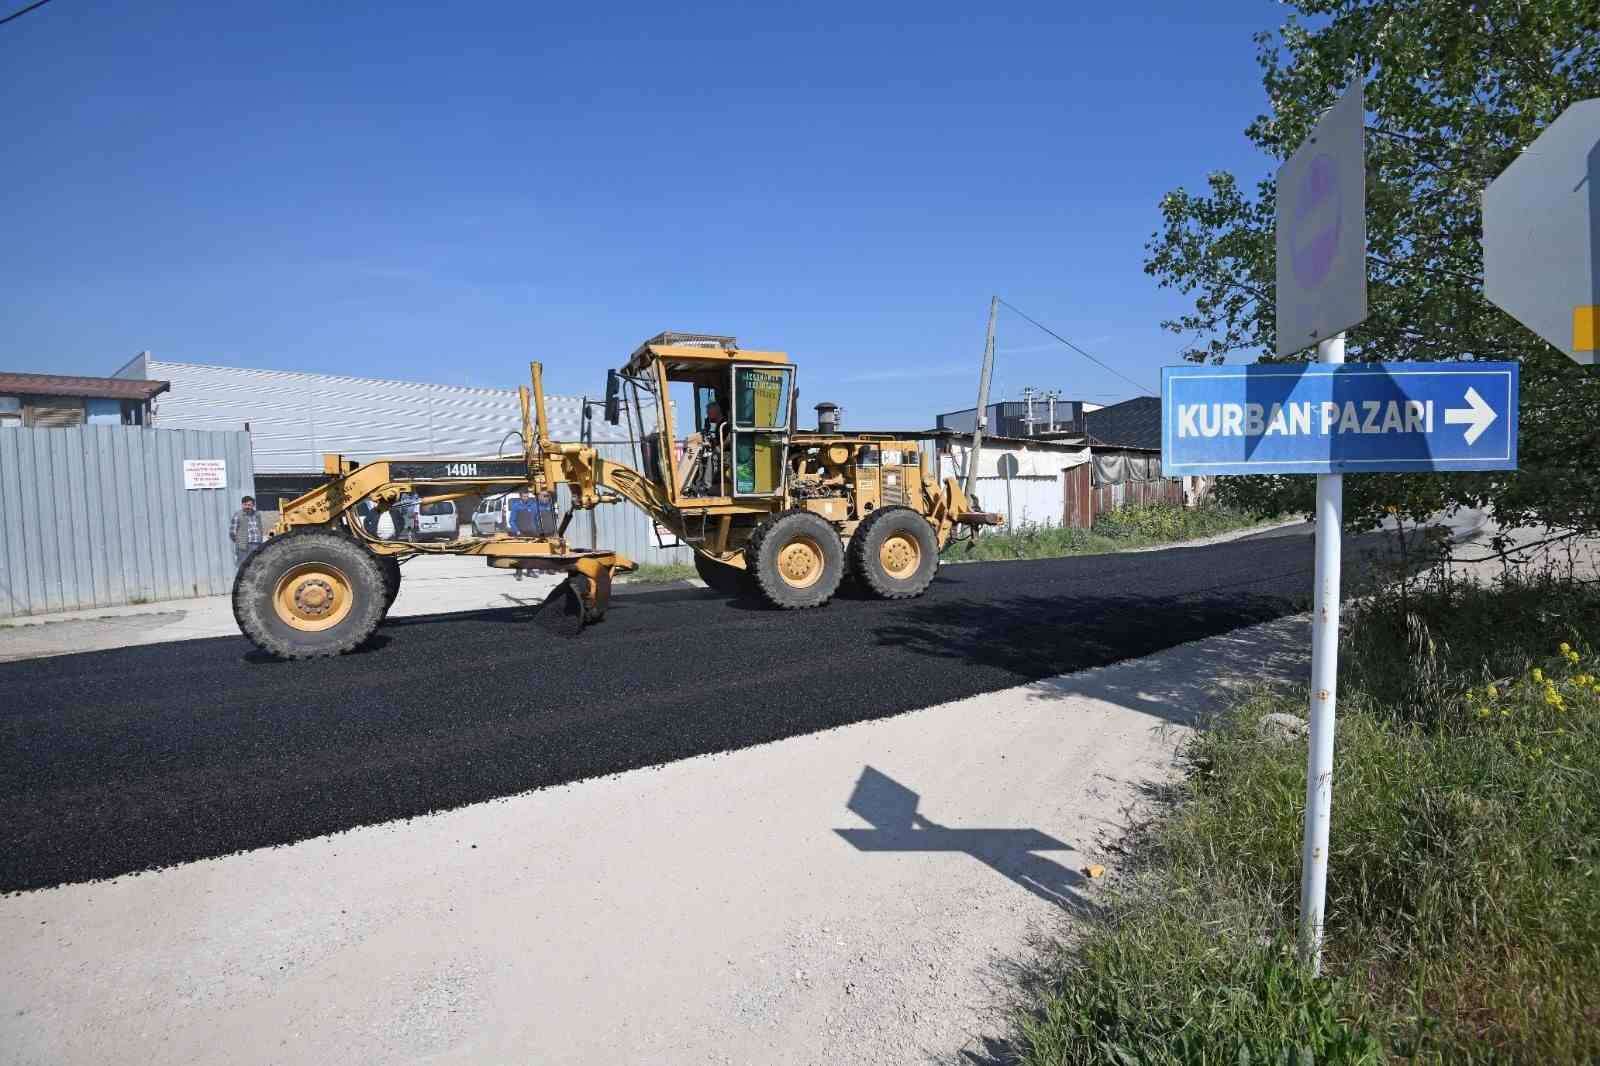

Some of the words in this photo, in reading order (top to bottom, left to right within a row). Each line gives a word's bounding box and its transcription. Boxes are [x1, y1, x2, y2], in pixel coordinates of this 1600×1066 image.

[1178, 401, 1311, 438] KURBAN
[1320, 399, 1434, 435] PAZARI
[444, 463, 478, 476] 140H
